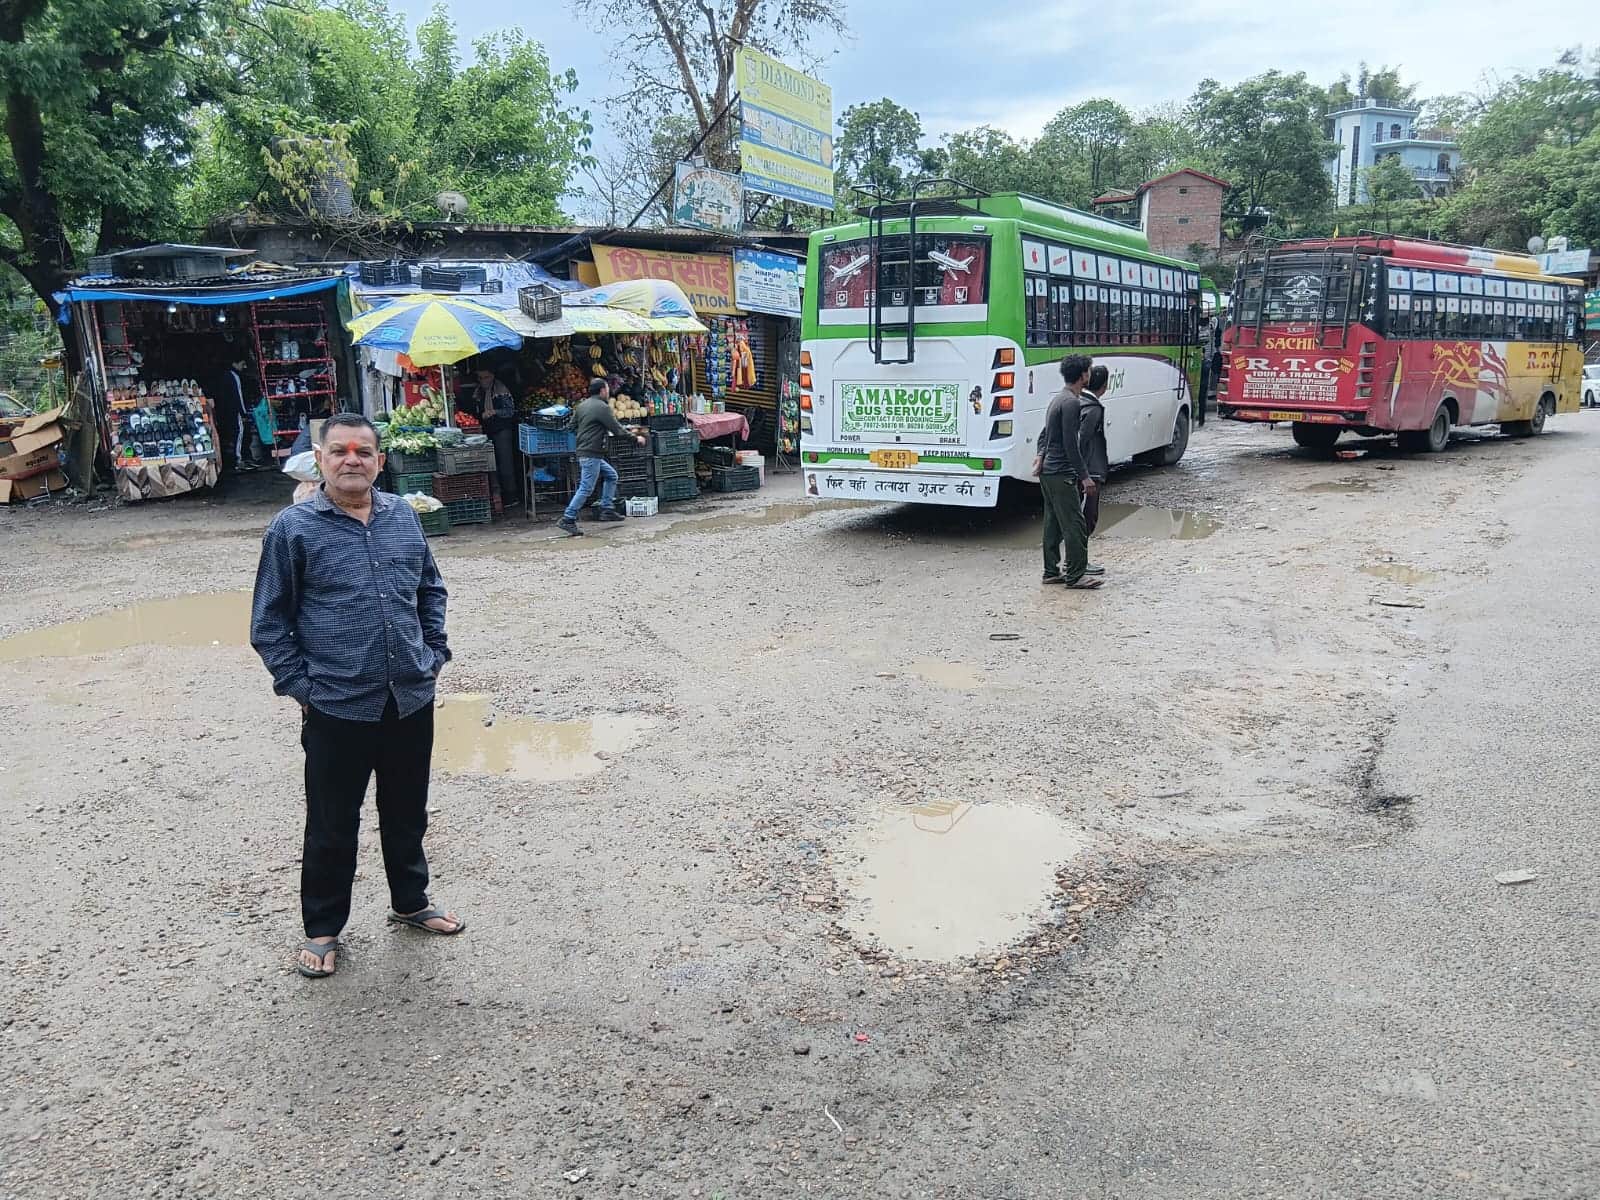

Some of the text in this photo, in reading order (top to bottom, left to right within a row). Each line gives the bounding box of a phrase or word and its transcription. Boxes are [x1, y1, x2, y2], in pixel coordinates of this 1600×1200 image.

[761, 60, 816, 102] DIAMOND
[689, 294, 728, 307] ATION
[1265, 338, 1319, 350] SACHI
[1246, 358, 1339, 372] R.T.C
[1108, 368, 1125, 394] rjot
[853, 388, 944, 405] AMARJOT
[855, 406, 943, 416] BUS SERVICE
[940, 450, 970, 458] DISTANCE
[826, 475, 844, 489] फिर
[874, 480, 910, 493] तलाश
[955, 480, 976, 496] की
